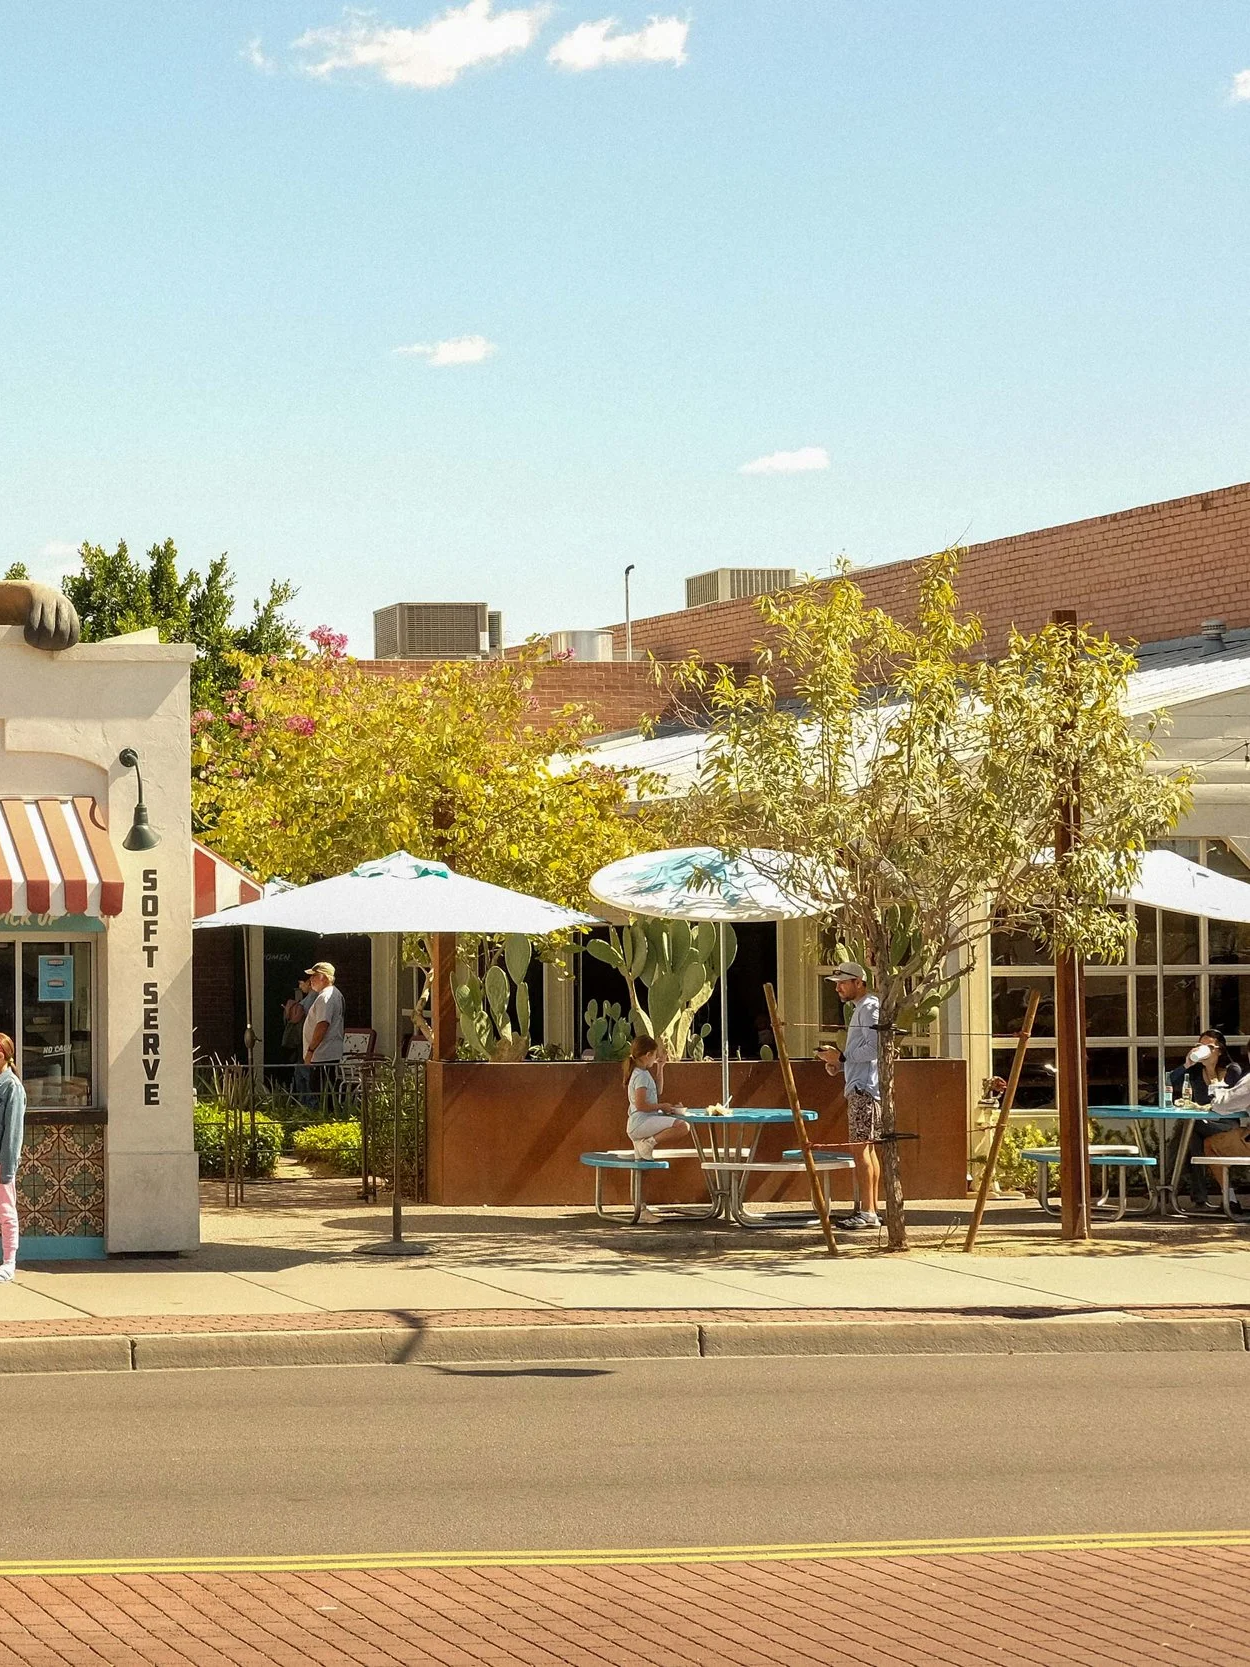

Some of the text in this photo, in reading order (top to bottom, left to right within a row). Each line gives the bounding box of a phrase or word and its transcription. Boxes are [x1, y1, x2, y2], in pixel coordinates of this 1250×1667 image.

[42, 1044, 73, 1055] NO CASH
[141, 869, 160, 1106] SOFT SERVE
